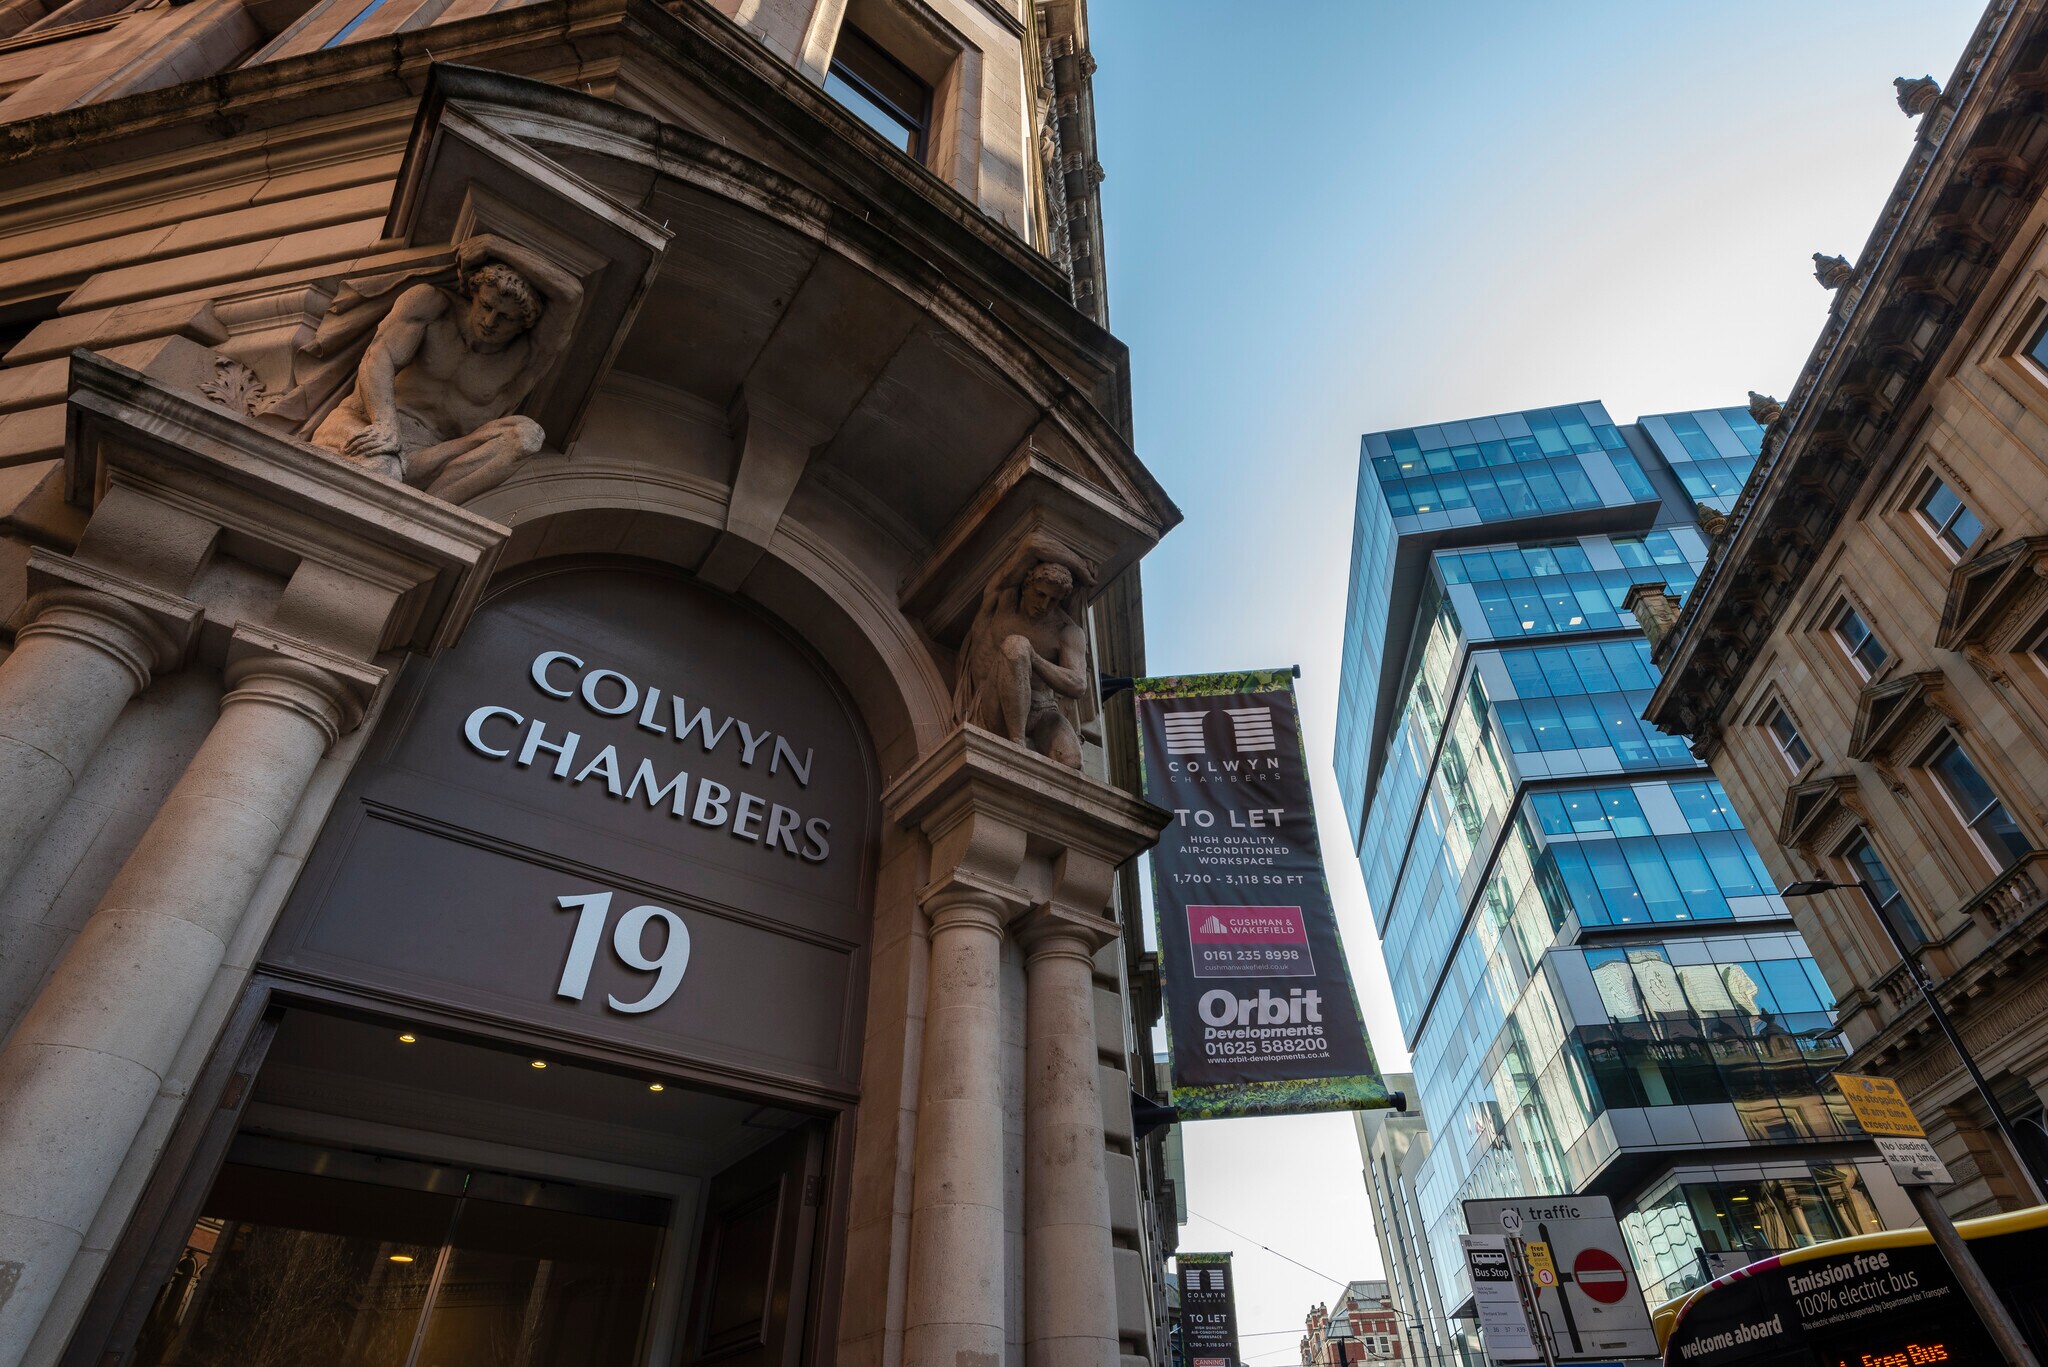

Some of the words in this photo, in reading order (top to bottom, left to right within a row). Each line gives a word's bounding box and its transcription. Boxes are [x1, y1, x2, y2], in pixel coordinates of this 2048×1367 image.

[531, 651, 813, 785] COLWYN
[1168, 757, 1280, 772] COLWYN
[465, 706, 831, 861] CHAMBERS
[1170, 772, 1281, 783] CHAMBERS
[1174, 809, 1215, 828] TO
[1230, 808, 1285, 828] LET
[1190, 835, 1219, 844] HIGH
[1224, 836, 1275, 844] QUALITY
[1180, 845, 1289, 855] AIR-CONDITIONED
[1198, 857, 1274, 865] WORKSPACE
[1173, 873, 1211, 885] 1,700
[1226, 874, 1259, 885] 3,118
[1263, 875, 1283, 885] SQ
[1287, 875, 1304, 885] FT
[1230, 918, 1283, 926] CUSHMAN
[1285, 918, 1293, 926] &
[1230, 926, 1295, 934] WAKEFIELD
[557, 892, 691, 1013] 19
[1203, 950, 1232, 961] 0161
[1237, 950, 1261, 961] 235
[1265, 950, 1299, 961] 8998
[1204, 962, 1289, 971] cushmanwakefield.co.uk
[1198, 988, 1323, 1027] Orbit
[1204, 1024, 1324, 1040] Developments
[1205, 1041, 1256, 1056] 01625
[1261, 1037, 1328, 1053] 588200
[1207, 1051, 1330, 1064] www.orbit-developments.co.uk
[1848, 1092, 1861, 1102] No
[1864, 1093, 1905, 1108] stopping
[1859, 1106, 1870, 1115] at
[1871, 1109, 1886, 1118] any
[1888, 1107, 1907, 1118] time
[1863, 1120, 1891, 1131] except
[1894, 1122, 1920, 1132] buses
[1880, 1142, 1895, 1151] No
[1896, 1141, 1929, 1152] loading
[1889, 1153, 1898, 1162] at
[1900, 1155, 1915, 1163] any
[1917, 1153, 1936, 1162] time
[1529, 1205, 1580, 1220] traffic
[1503, 1216, 1520, 1229] CV
[1475, 1268, 1490, 1277] Bus
[1490, 1268, 1509, 1279] Stop
[1788, 1264, 1854, 1296] Emission
[1853, 1252, 1890, 1276] free
[1796, 1290, 1838, 1318] 100%
[1839, 1277, 1890, 1306] electric
[1888, 1270, 1919, 1292] bus
[1802, 1322, 1812, 1330] This
[1812, 1318, 1828, 1328] electric
[1828, 1313, 1845, 1323] vehicle
[1845, 1311, 1850, 1319] is
[1850, 1305, 1874, 1319] supported
[1874, 1303, 1882, 1313] by
[1881, 1296, 1913, 1310] Department
[1913, 1292, 1921, 1303] for
[1921, 1286, 1950, 1300] Transport
[1189, 1314, 1203, 1323] TO
[1207, 1314, 1227, 1323] LET
[1681, 1332, 1734, 1359] welcome
[1734, 1314, 1783, 1344] aboard
[1907, 1344, 1948, 1365] Bus
